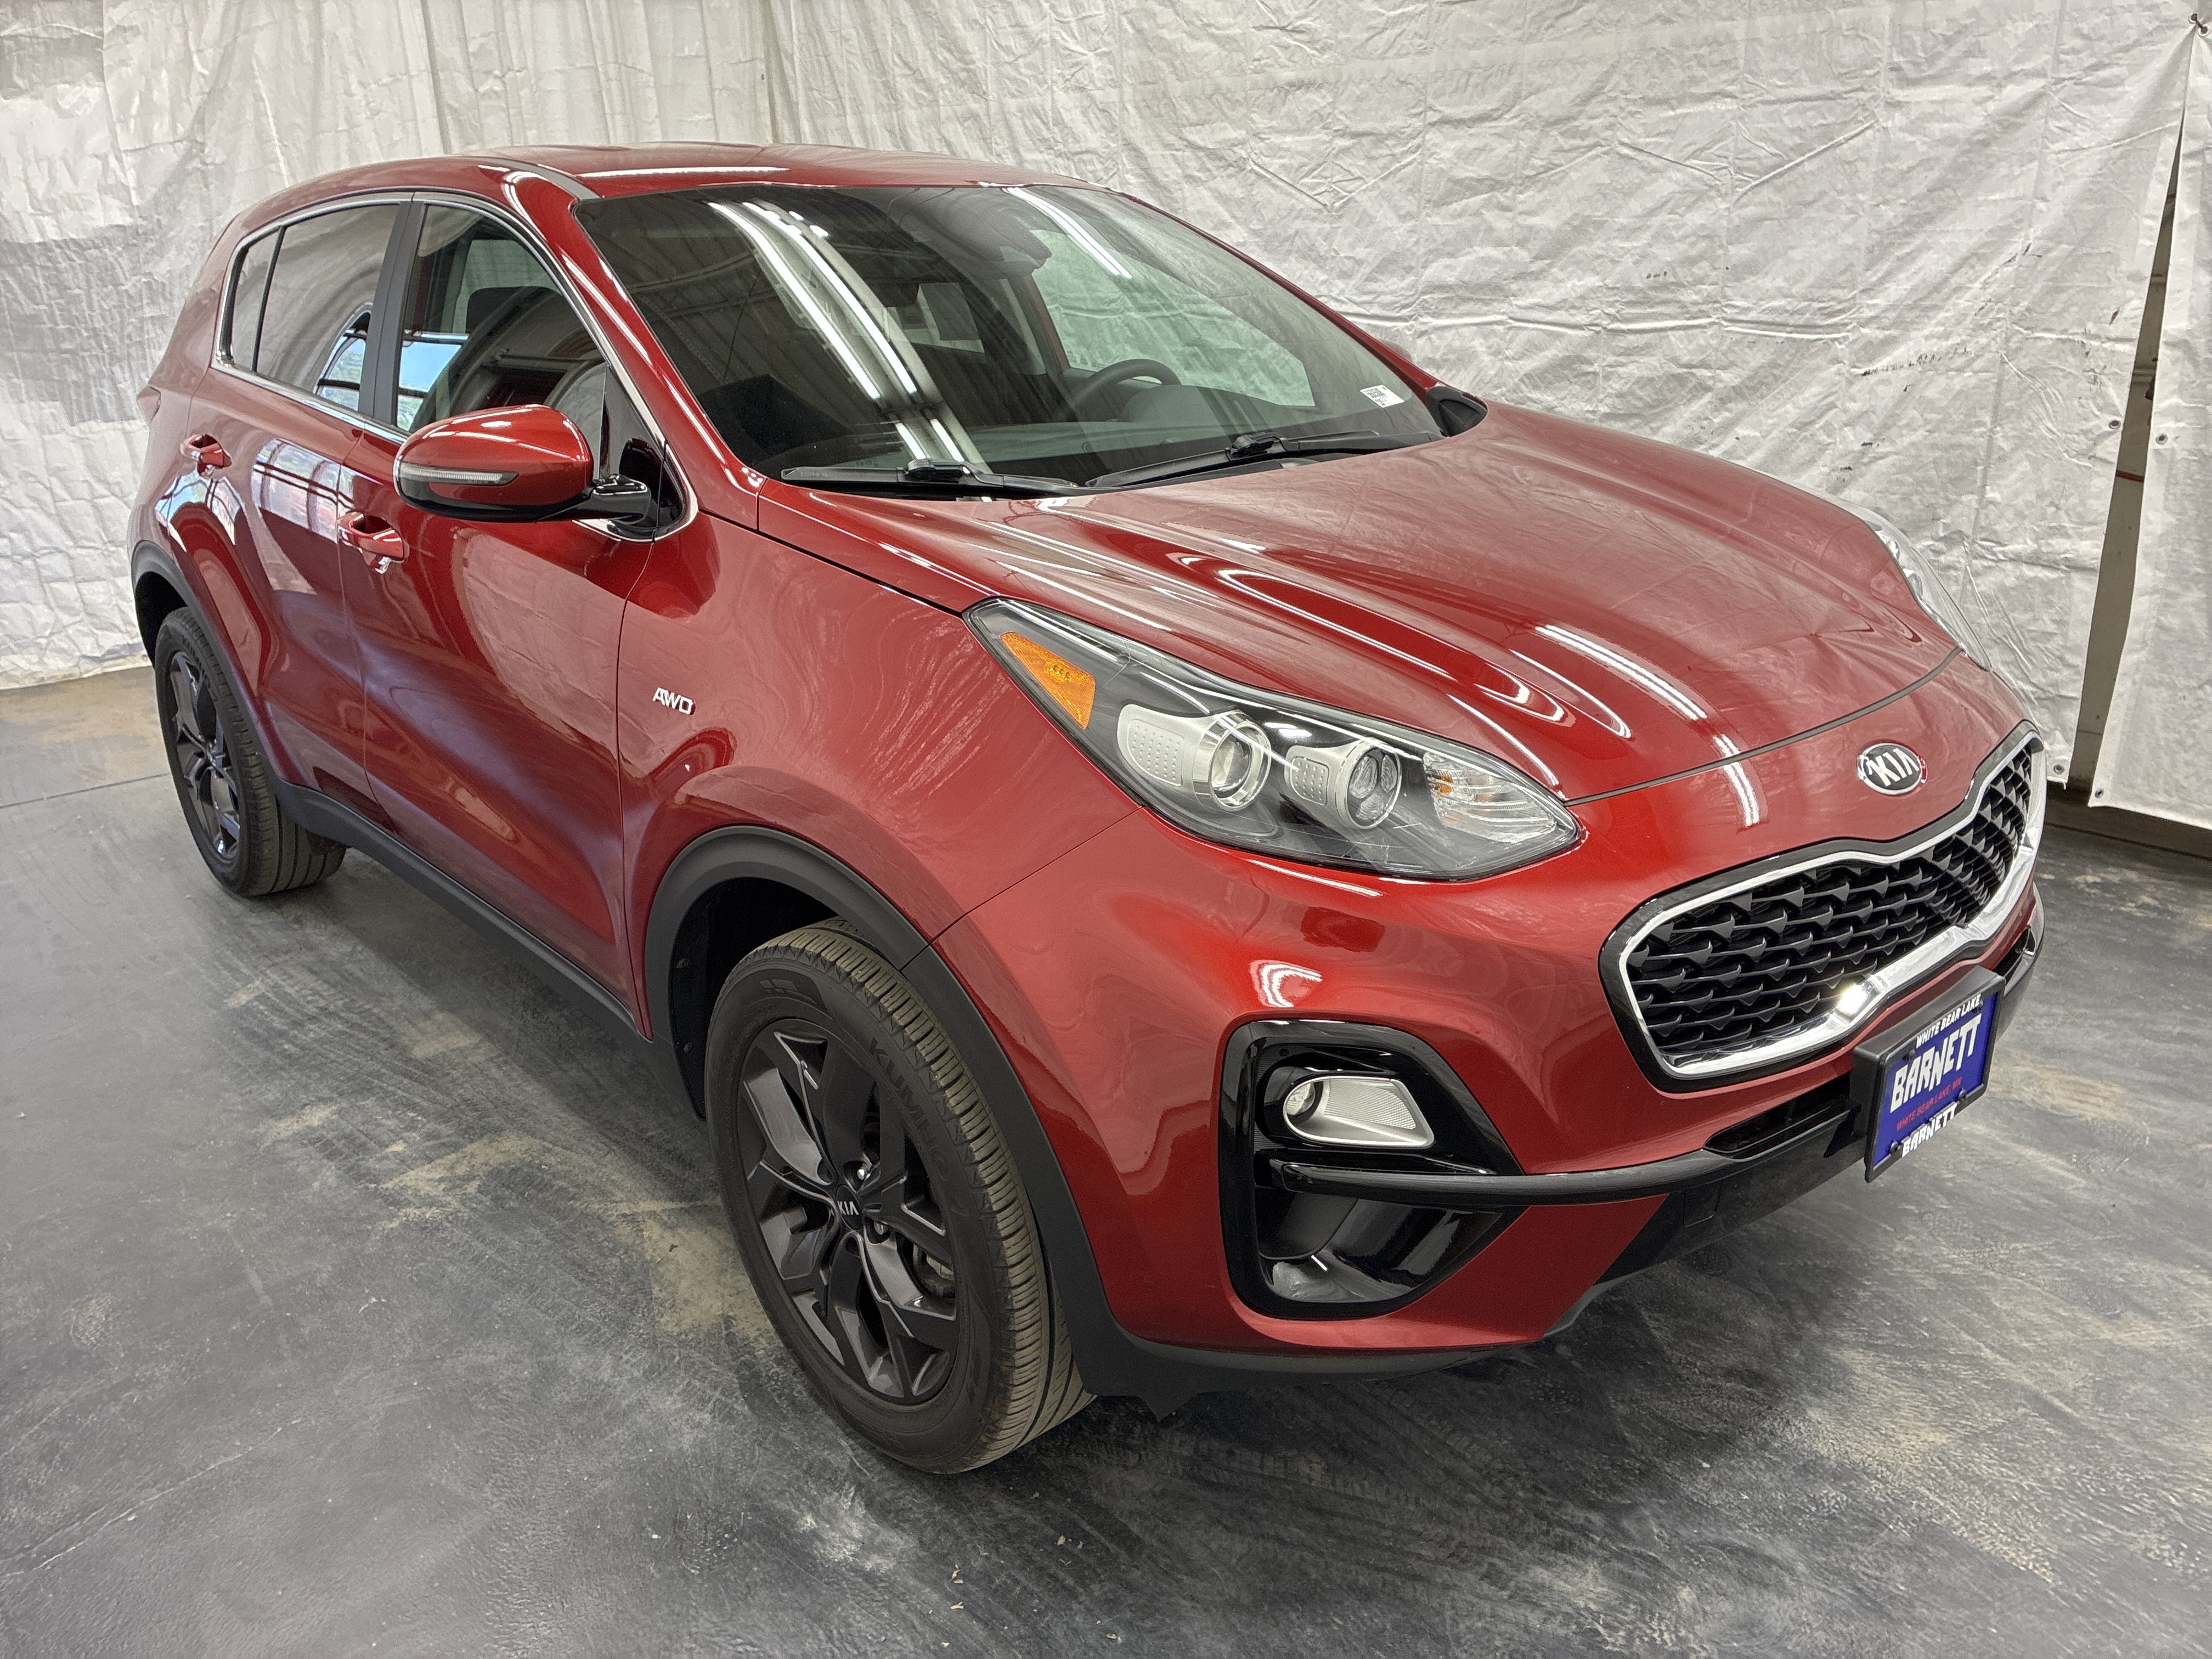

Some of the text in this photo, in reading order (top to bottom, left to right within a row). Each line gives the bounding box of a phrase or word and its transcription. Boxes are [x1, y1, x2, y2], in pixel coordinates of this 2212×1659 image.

[652, 687, 694, 715] AWD
[1868, 748, 1920, 787] KIA
[1916, 994, 1982, 1049] WHITE BEAR LAKE
[1890, 1013, 1982, 1113] BARNETT
[1896, 1110, 1917, 1131] WHITE
[1916, 1098, 1934, 1116] BEAR
[1902, 1102, 1958, 1158] BARNETT
[837, 1201, 860, 1215] KIA
